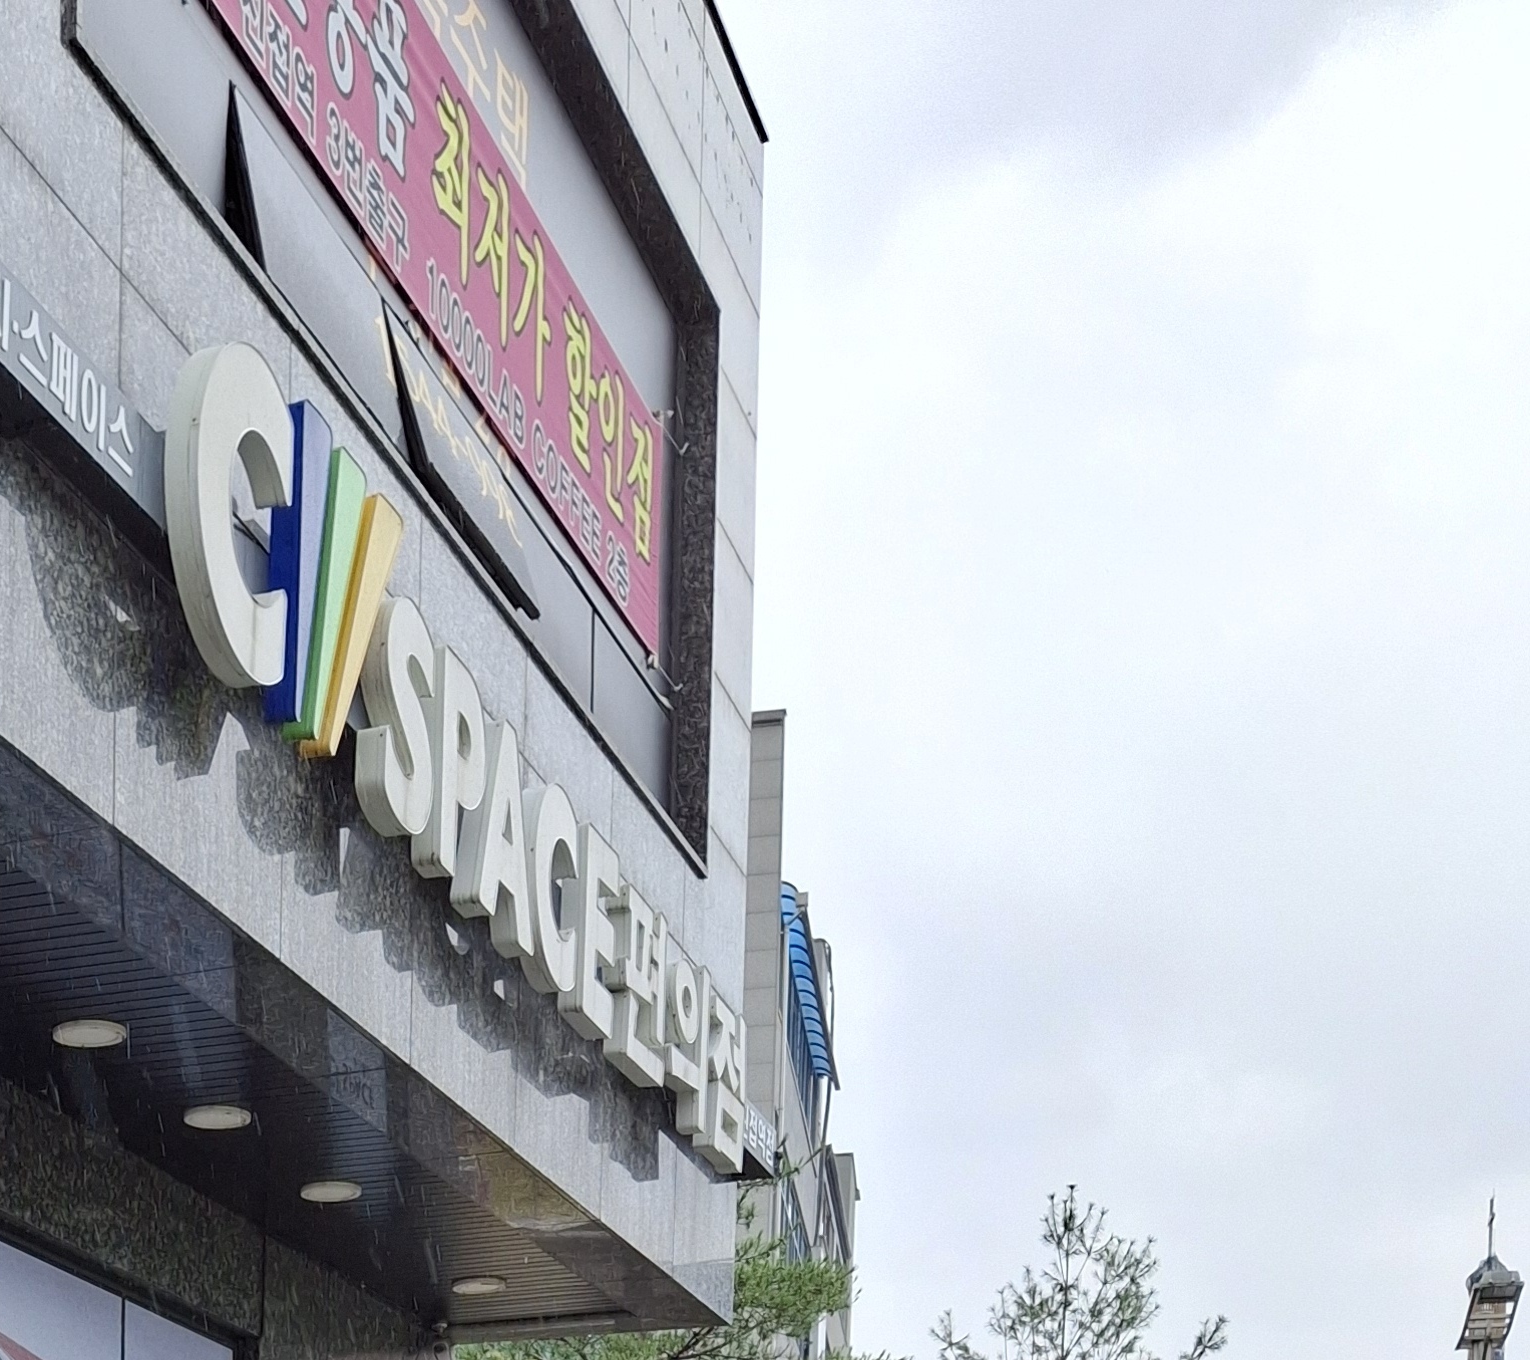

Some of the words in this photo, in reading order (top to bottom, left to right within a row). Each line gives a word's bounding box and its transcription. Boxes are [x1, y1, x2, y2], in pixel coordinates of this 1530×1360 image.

[326, 103, 410, 272] 3번출구
[426, 258, 525, 450] 10000LAB
[531, 420, 602, 565] COFFEE
[606, 531, 630, 606] 2층
[432, 78, 549, 402] 최저가
[563, 296, 654, 564] 할인점
[605, 884, 746, 1174] 편의점
